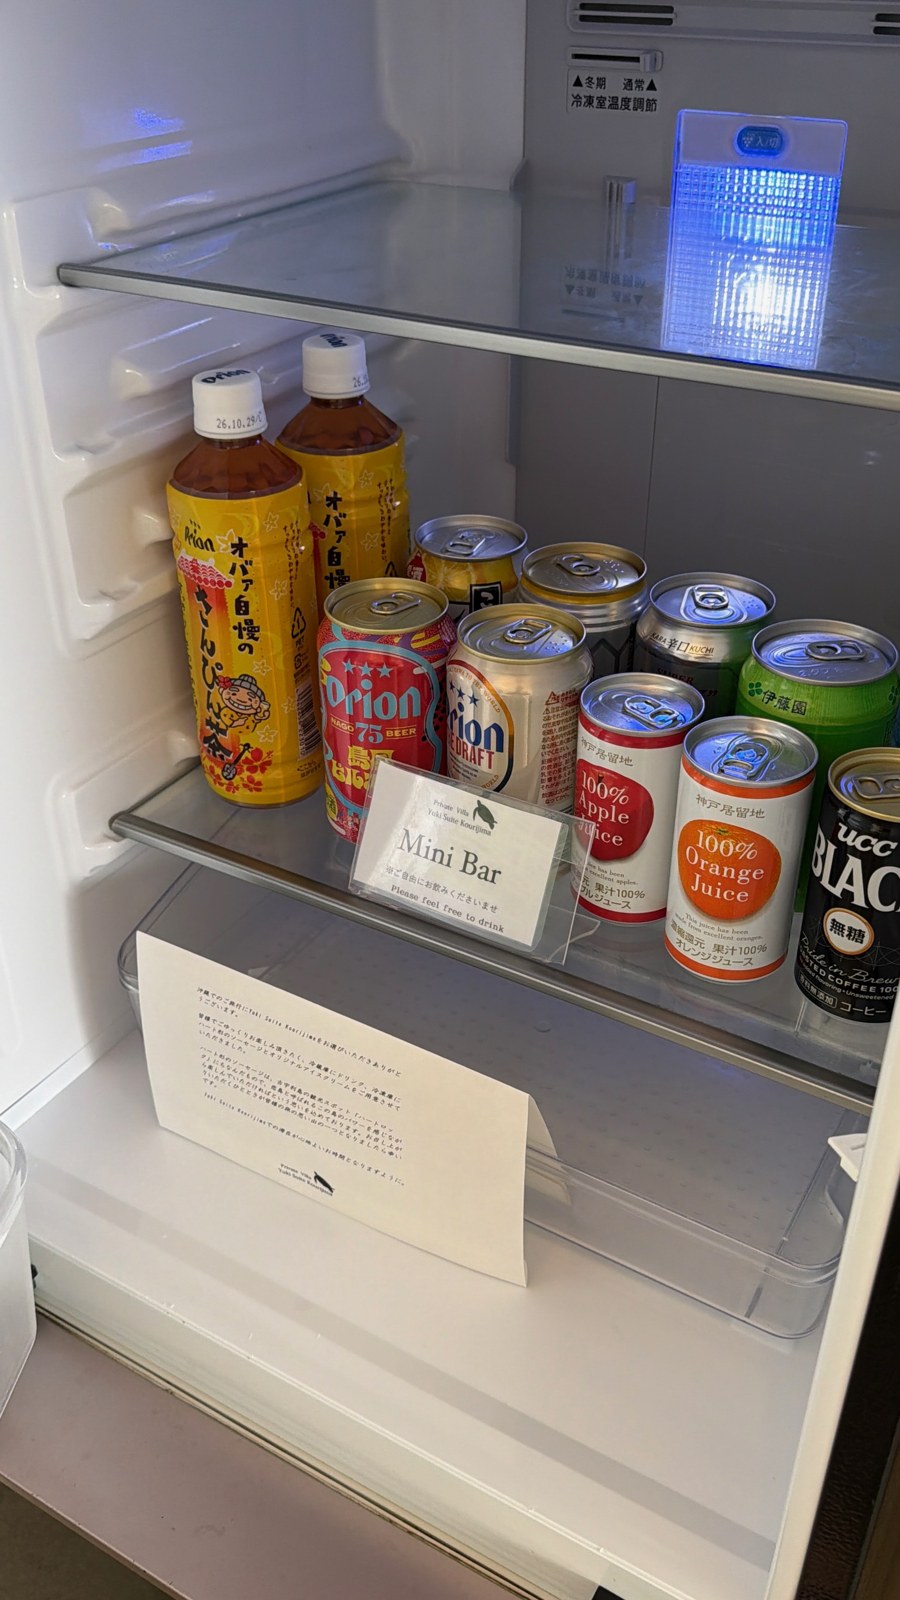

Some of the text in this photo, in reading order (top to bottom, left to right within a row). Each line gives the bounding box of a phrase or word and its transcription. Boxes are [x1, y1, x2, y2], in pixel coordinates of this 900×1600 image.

[585, 76, 645, 91] 冬期 通常
[571, 93, 658, 112] 冷凍室温度調節
[201, 369, 252, 384] Orion
[184, 525, 216, 553] Orion
[229, 536, 261, 656] オバァ自慢の
[326, 679, 422, 720] Orion
[762, 690, 808, 716] 伊藤園
[330, 715, 417, 744] NAGO 75 BEER
[448, 702, 504, 753] rion
[455, 736, 495, 770] DRAFT
[581, 736, 634, 766] 神戸居留地
[582, 770, 630, 806] 100%
[433, 798, 470, 817] Private Villa
[579, 790, 630, 824] Apple
[696, 793, 766, 819] 神戸居留地
[427, 808, 492, 837] Yuki Suite Kourijima
[397, 828, 502, 885] Mini Bar
[697, 829, 758, 860] 100%
[686, 845, 765, 885] Orange
[811, 823, 900, 914] BLAC
[595, 882, 646, 899] 果汁100%
[691, 872, 749, 902] Juice
[391, 884, 505, 934] Please feel free to drink
[685, 912, 749, 935] This juice has been
[688, 922, 702, 933] from
[703, 930, 734, 941] excellent
[829, 918, 866, 945] 無糖
[676, 937, 754, 967] オレンジジュース
[712, 943, 768, 956] 果汁100%
[827, 974, 877, 993] COFFEE
[828, 963, 848, 976] in
[839, 1001, 887, 1016] コーヒー
